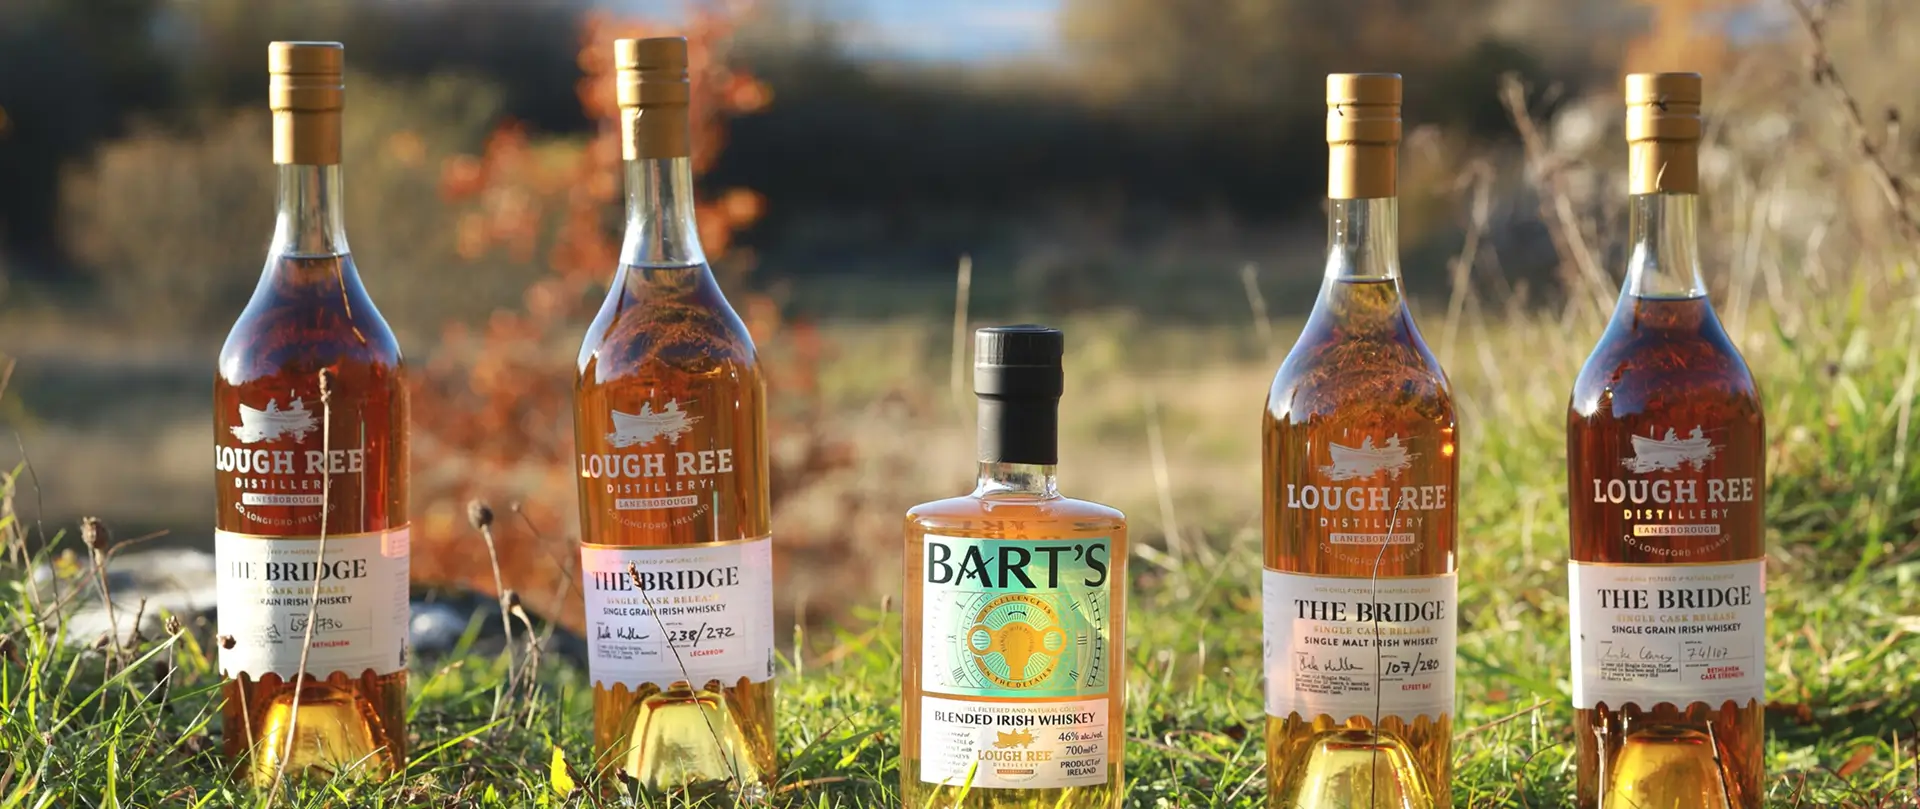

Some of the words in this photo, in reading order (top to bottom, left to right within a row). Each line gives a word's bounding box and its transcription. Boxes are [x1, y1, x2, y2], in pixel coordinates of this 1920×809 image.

[216, 445, 294, 474] LOUGH
[305, 448, 363, 474] REE
[581, 454, 666, 479] LOUGH
[675, 449, 733, 476] REE
[235, 478, 333, 490] DISTILLERY
[607, 479, 707, 494] DISTILLERY
[1593, 478, 1698, 504] LOUGH
[1707, 477, 1753, 502] REE
[619, 497, 694, 508] LANESBOROUGH
[1286, 484, 1391, 511] LOUGH
[1400, 485, 1446, 510] REE
[1623, 509, 1729, 520] DISTILLERY
[1320, 517, 1424, 529] DISTILLERY
[1638, 526, 1717, 534] LANESBOROUGH
[1639, 543, 1691, 557] LONGFORD
[266, 559, 367, 581] BRIDGE
[928, 542, 1107, 589] BART'S
[593, 571, 632, 591] THE
[641, 566, 739, 591] BRIDGE
[283, 598, 308, 606] IRISH
[1597, 588, 1649, 609] THE
[1657, 585, 1751, 609] BRIDGE
[603, 607, 628, 616] SINGLE
[629, 607, 656, 617] GRAIN
[659, 606, 684, 616] IRISH
[686, 604, 726, 614] WHISKEY
[1295, 599, 1347, 622] THE
[1356, 600, 1445, 622] BRIDGE
[1660, 614, 1688, 623] CASK
[669, 622, 735, 647] 238/272
[1611, 625, 1643, 634] SINGLE
[1644, 626, 1676, 634] GRAIN
[1678, 625, 1703, 634] IRISH
[1705, 623, 1741, 633] WHISKEY
[1304, 636, 1339, 647] SINGLE
[1342, 638, 1368, 647] MALT
[1372, 638, 1399, 647] IRISH
[1403, 637, 1438, 646] WHISKEY
[1385, 652, 1439, 676] 107/280
[1015, 668, 1052, 688] DETAILS
[935, 711, 992, 725] BLENDED
[996, 715, 1034, 726] IRISH
[1038, 712, 1096, 725] WHISKEY
[1058, 731, 1079, 741] 46%
[977, 749, 1022, 762] LOUGH
[1026, 750, 1053, 762] REE
[1060, 759, 1094, 768] PRODUCT
[1067, 767, 1097, 776] IRELAND
